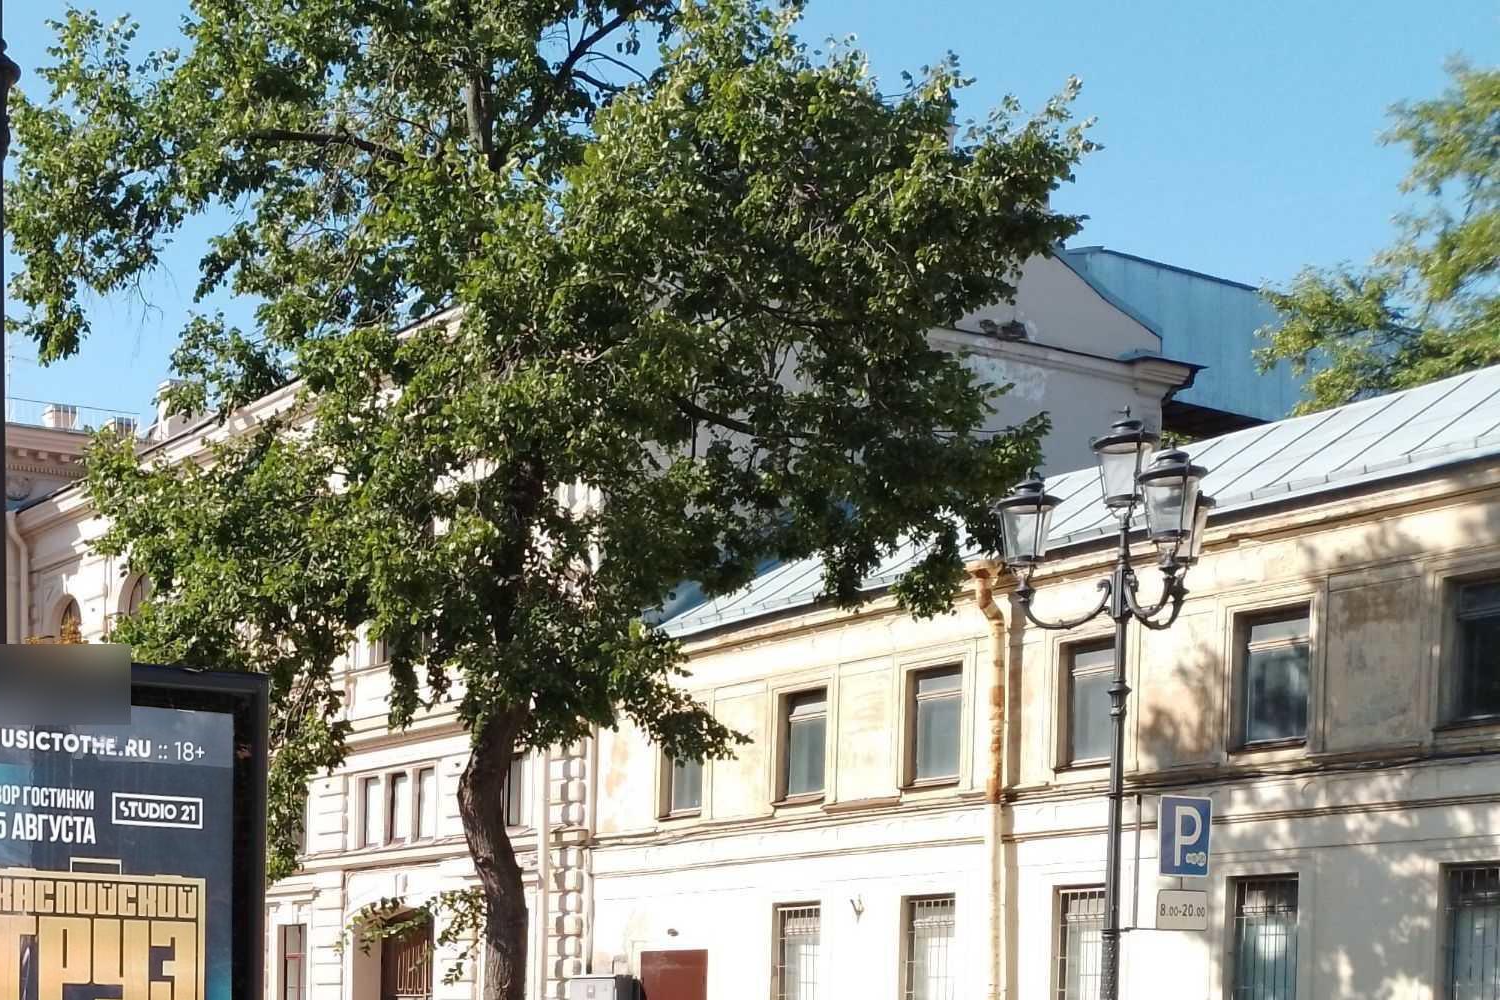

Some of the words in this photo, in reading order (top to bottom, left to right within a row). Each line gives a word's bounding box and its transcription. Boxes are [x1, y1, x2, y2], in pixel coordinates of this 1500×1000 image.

[174, 742, 205, 761] 18+
[23, 785, 95, 811] ГОСТИНКИ
[119, 802, 176, 820] STUDIO
[180, 805, 196, 821] 21
[11, 813, 97, 846] АВГУСТА
